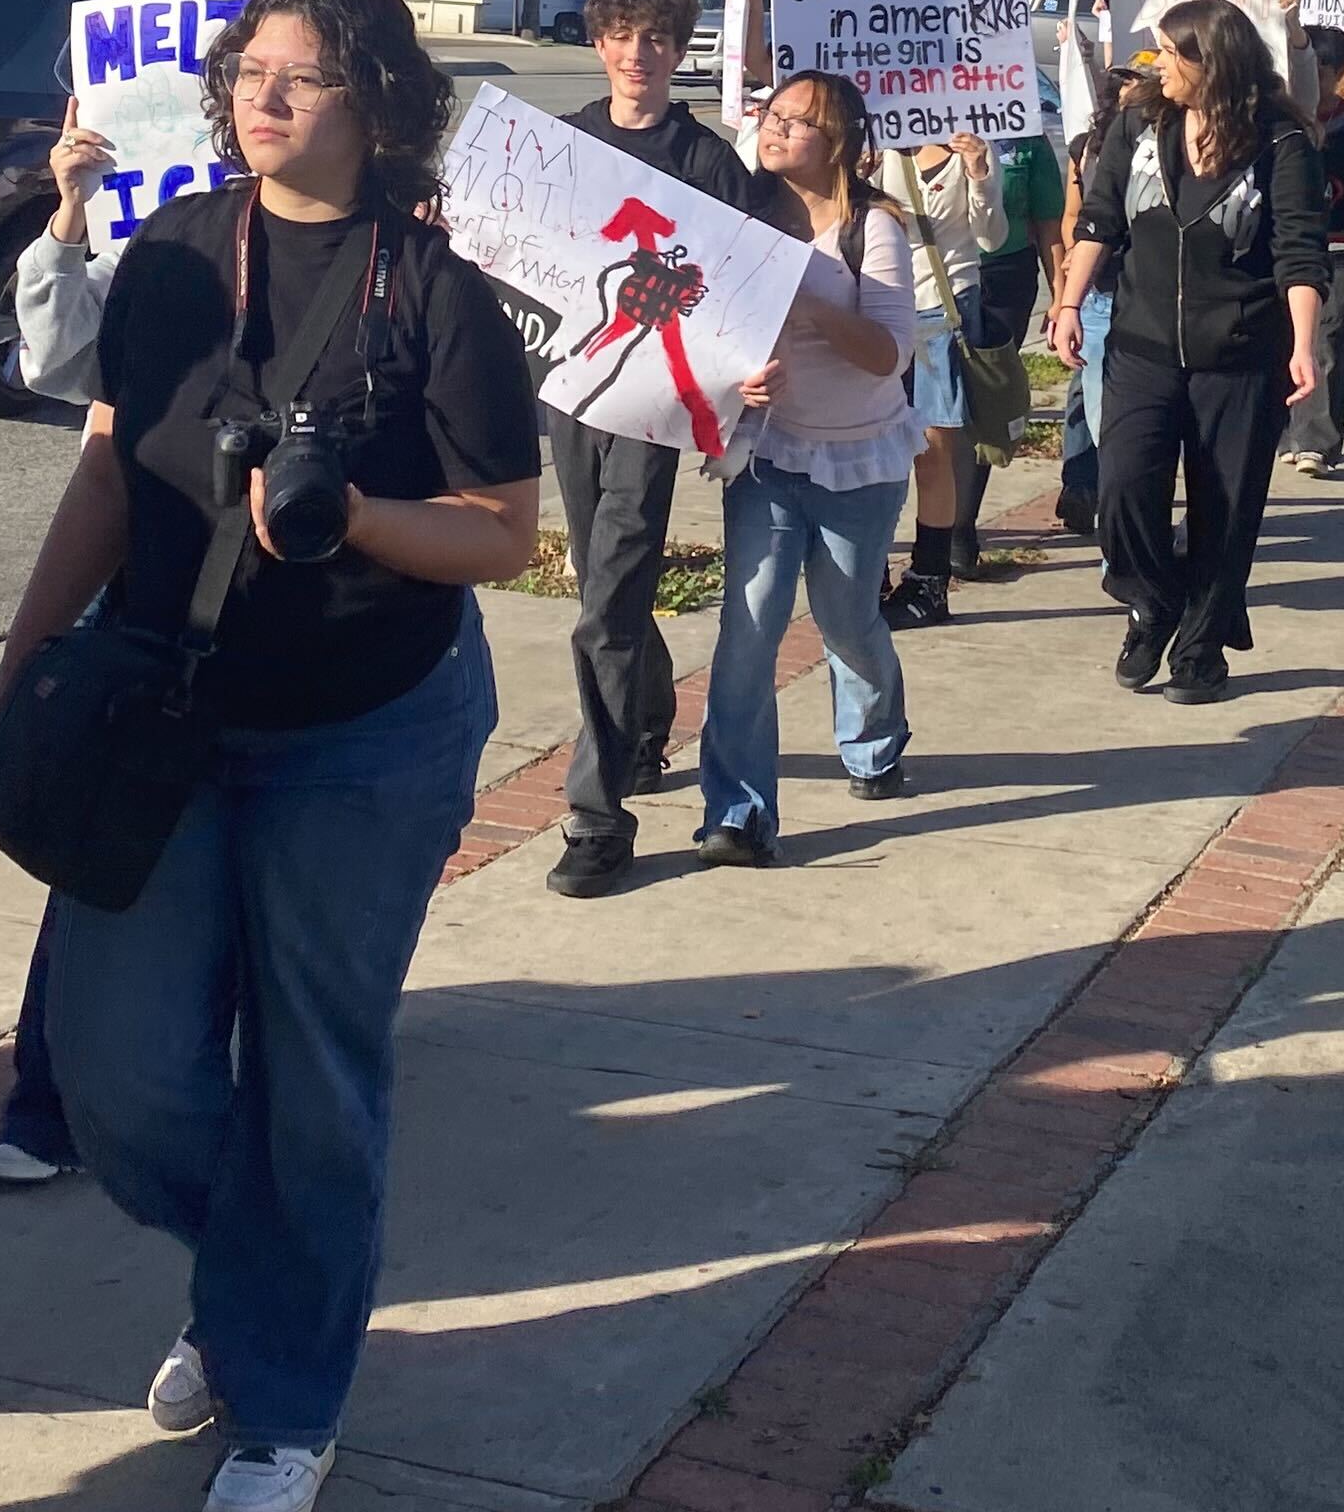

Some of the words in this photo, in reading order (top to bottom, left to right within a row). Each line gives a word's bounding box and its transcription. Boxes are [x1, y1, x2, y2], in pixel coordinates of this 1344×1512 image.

[829, 7, 857, 38] in
[777, 44, 795, 70] a
[815, 40, 893, 71] little
[897, 39, 945, 67] girl
[955, 37, 982, 64] is
[878, 69, 906, 96] in
[909, 67, 947, 96] an
[952, 64, 1025, 92] attic
[907, 105, 959, 138] abt
[965, 99, 1026, 135] this
[102, 161, 248, 241] IC
[466, 237, 498, 259] HE
[374, 248, 391, 298] Canon
[508, 257, 586, 296] MAGA
